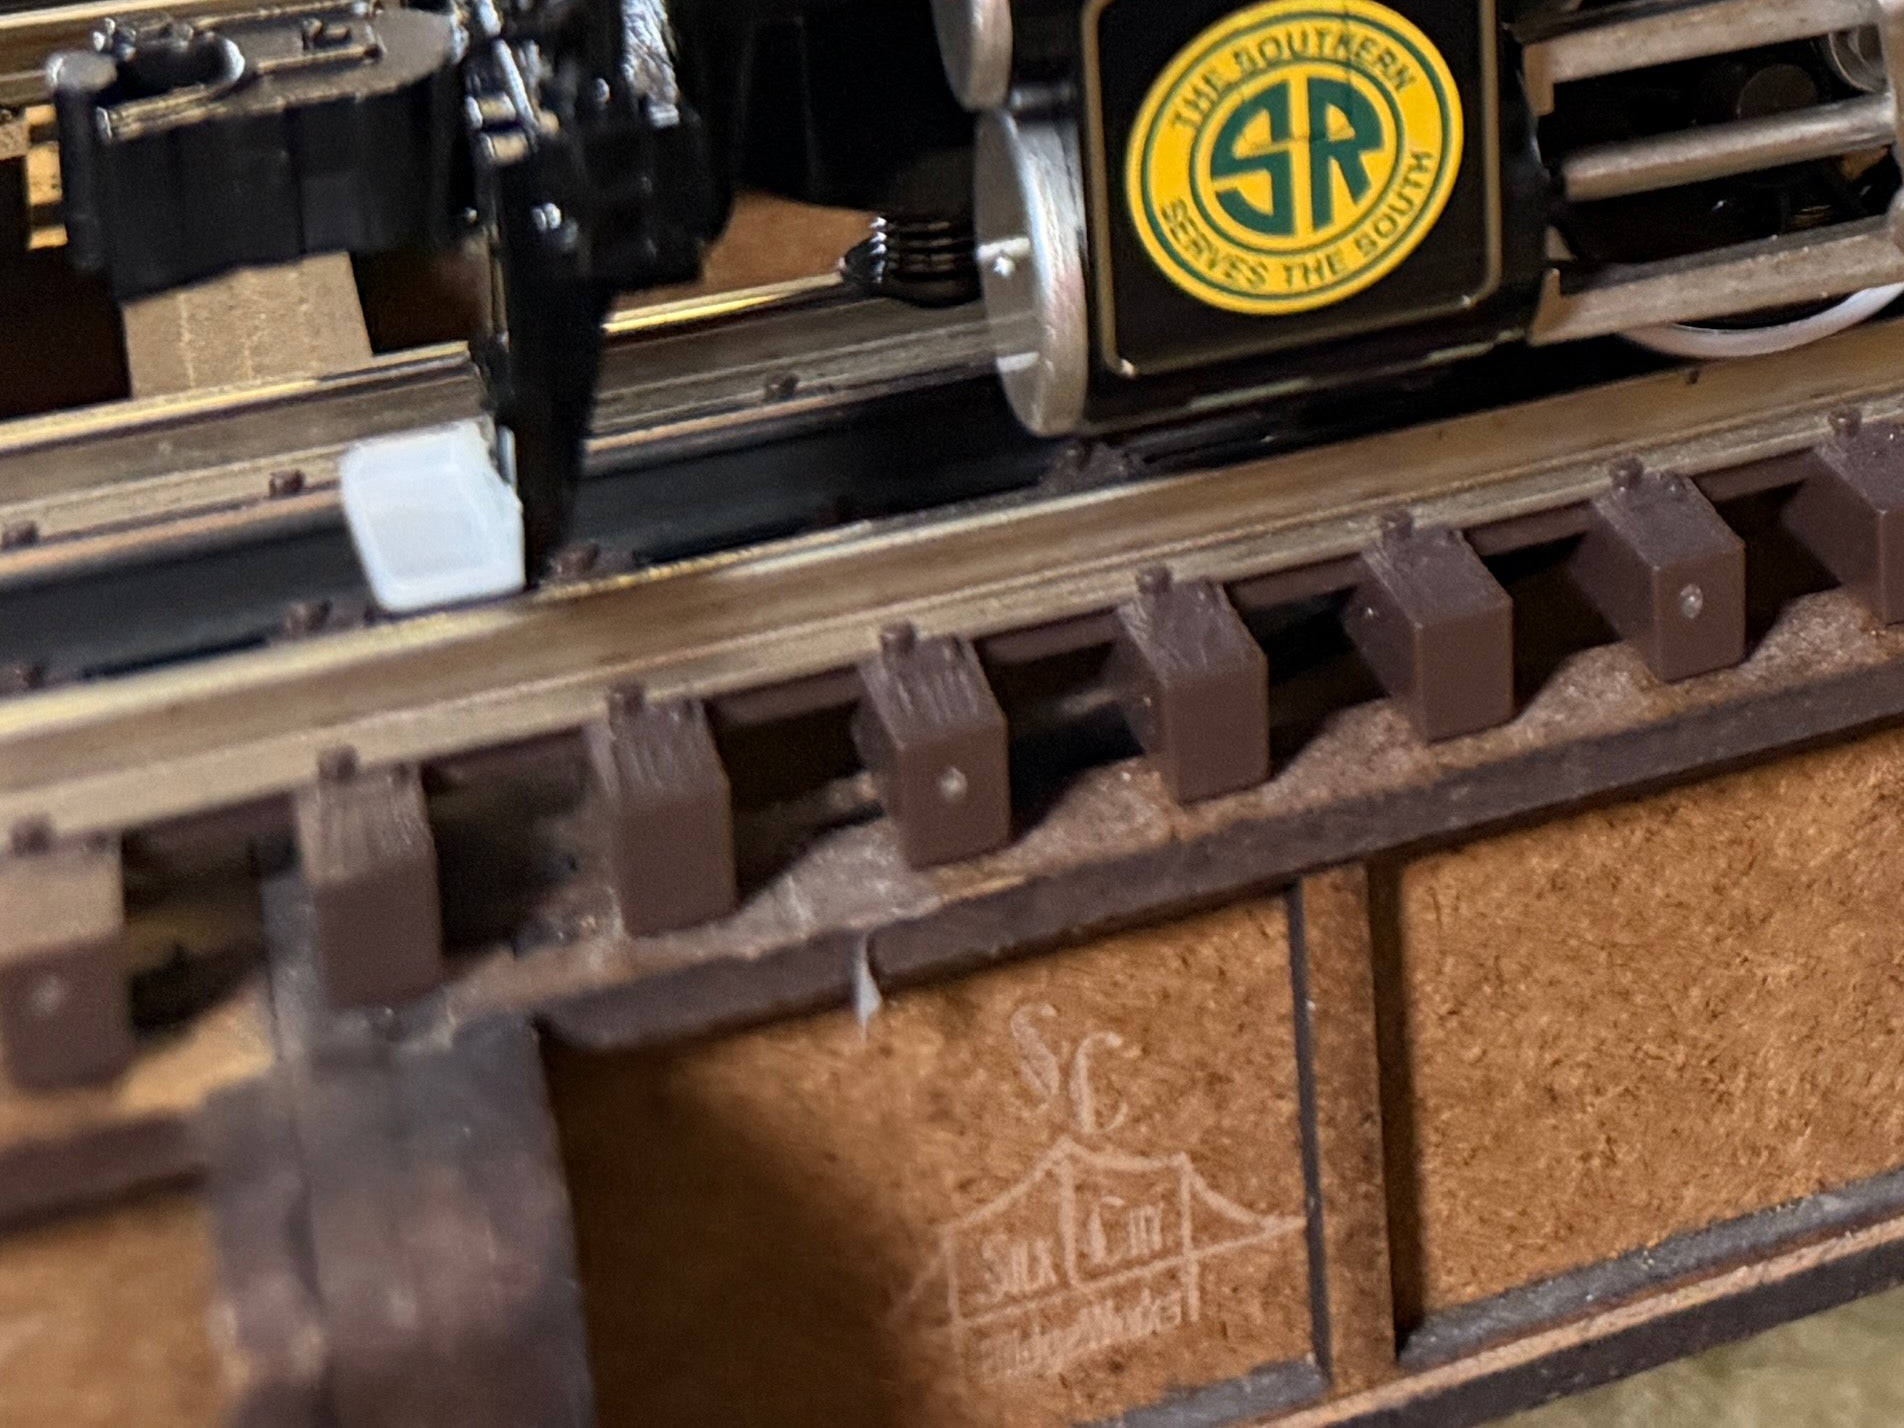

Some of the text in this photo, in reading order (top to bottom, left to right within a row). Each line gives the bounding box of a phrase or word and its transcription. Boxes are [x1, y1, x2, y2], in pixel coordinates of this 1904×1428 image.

[1172, 24, 1418, 130] THE SOUTHERN
[1160, 149, 1435, 288] SERVES THE SOUTH
[1210, 75, 1384, 237] SR
